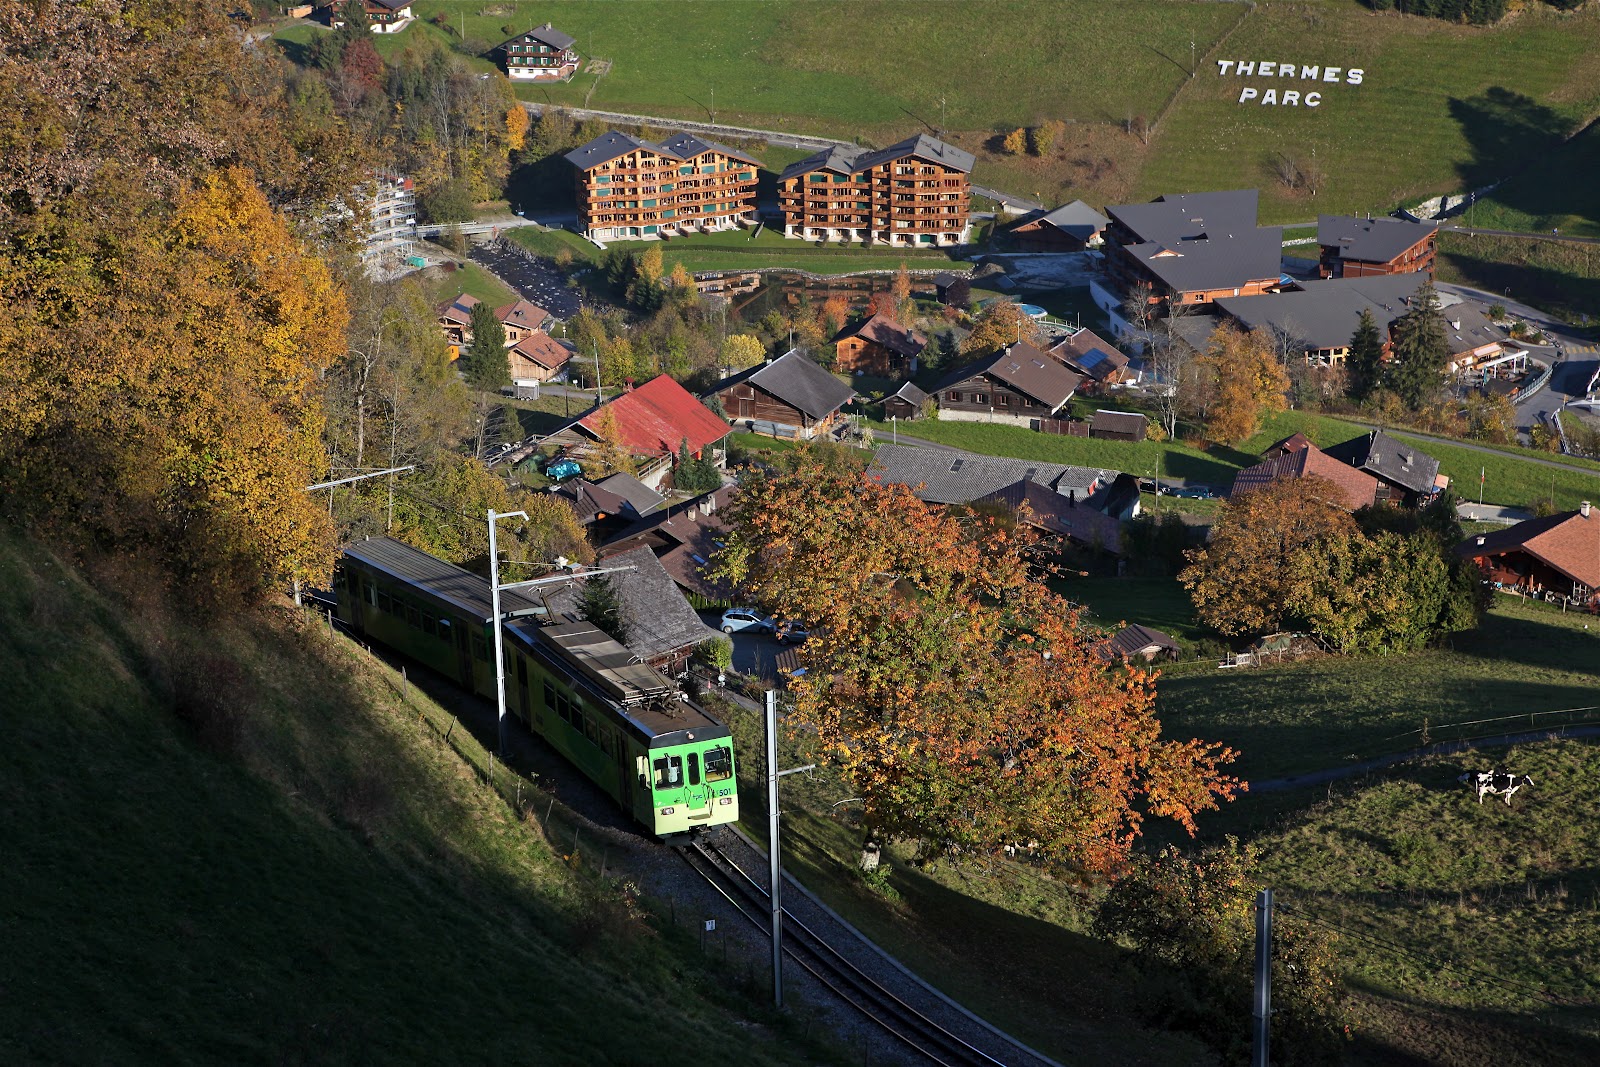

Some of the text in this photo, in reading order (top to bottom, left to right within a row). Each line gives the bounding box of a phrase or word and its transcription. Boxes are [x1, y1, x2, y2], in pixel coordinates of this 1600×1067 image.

[1217, 59, 1365, 85] THERMES
[1238, 87, 1322, 107] PARC
[719, 788, 732, 797] 501
